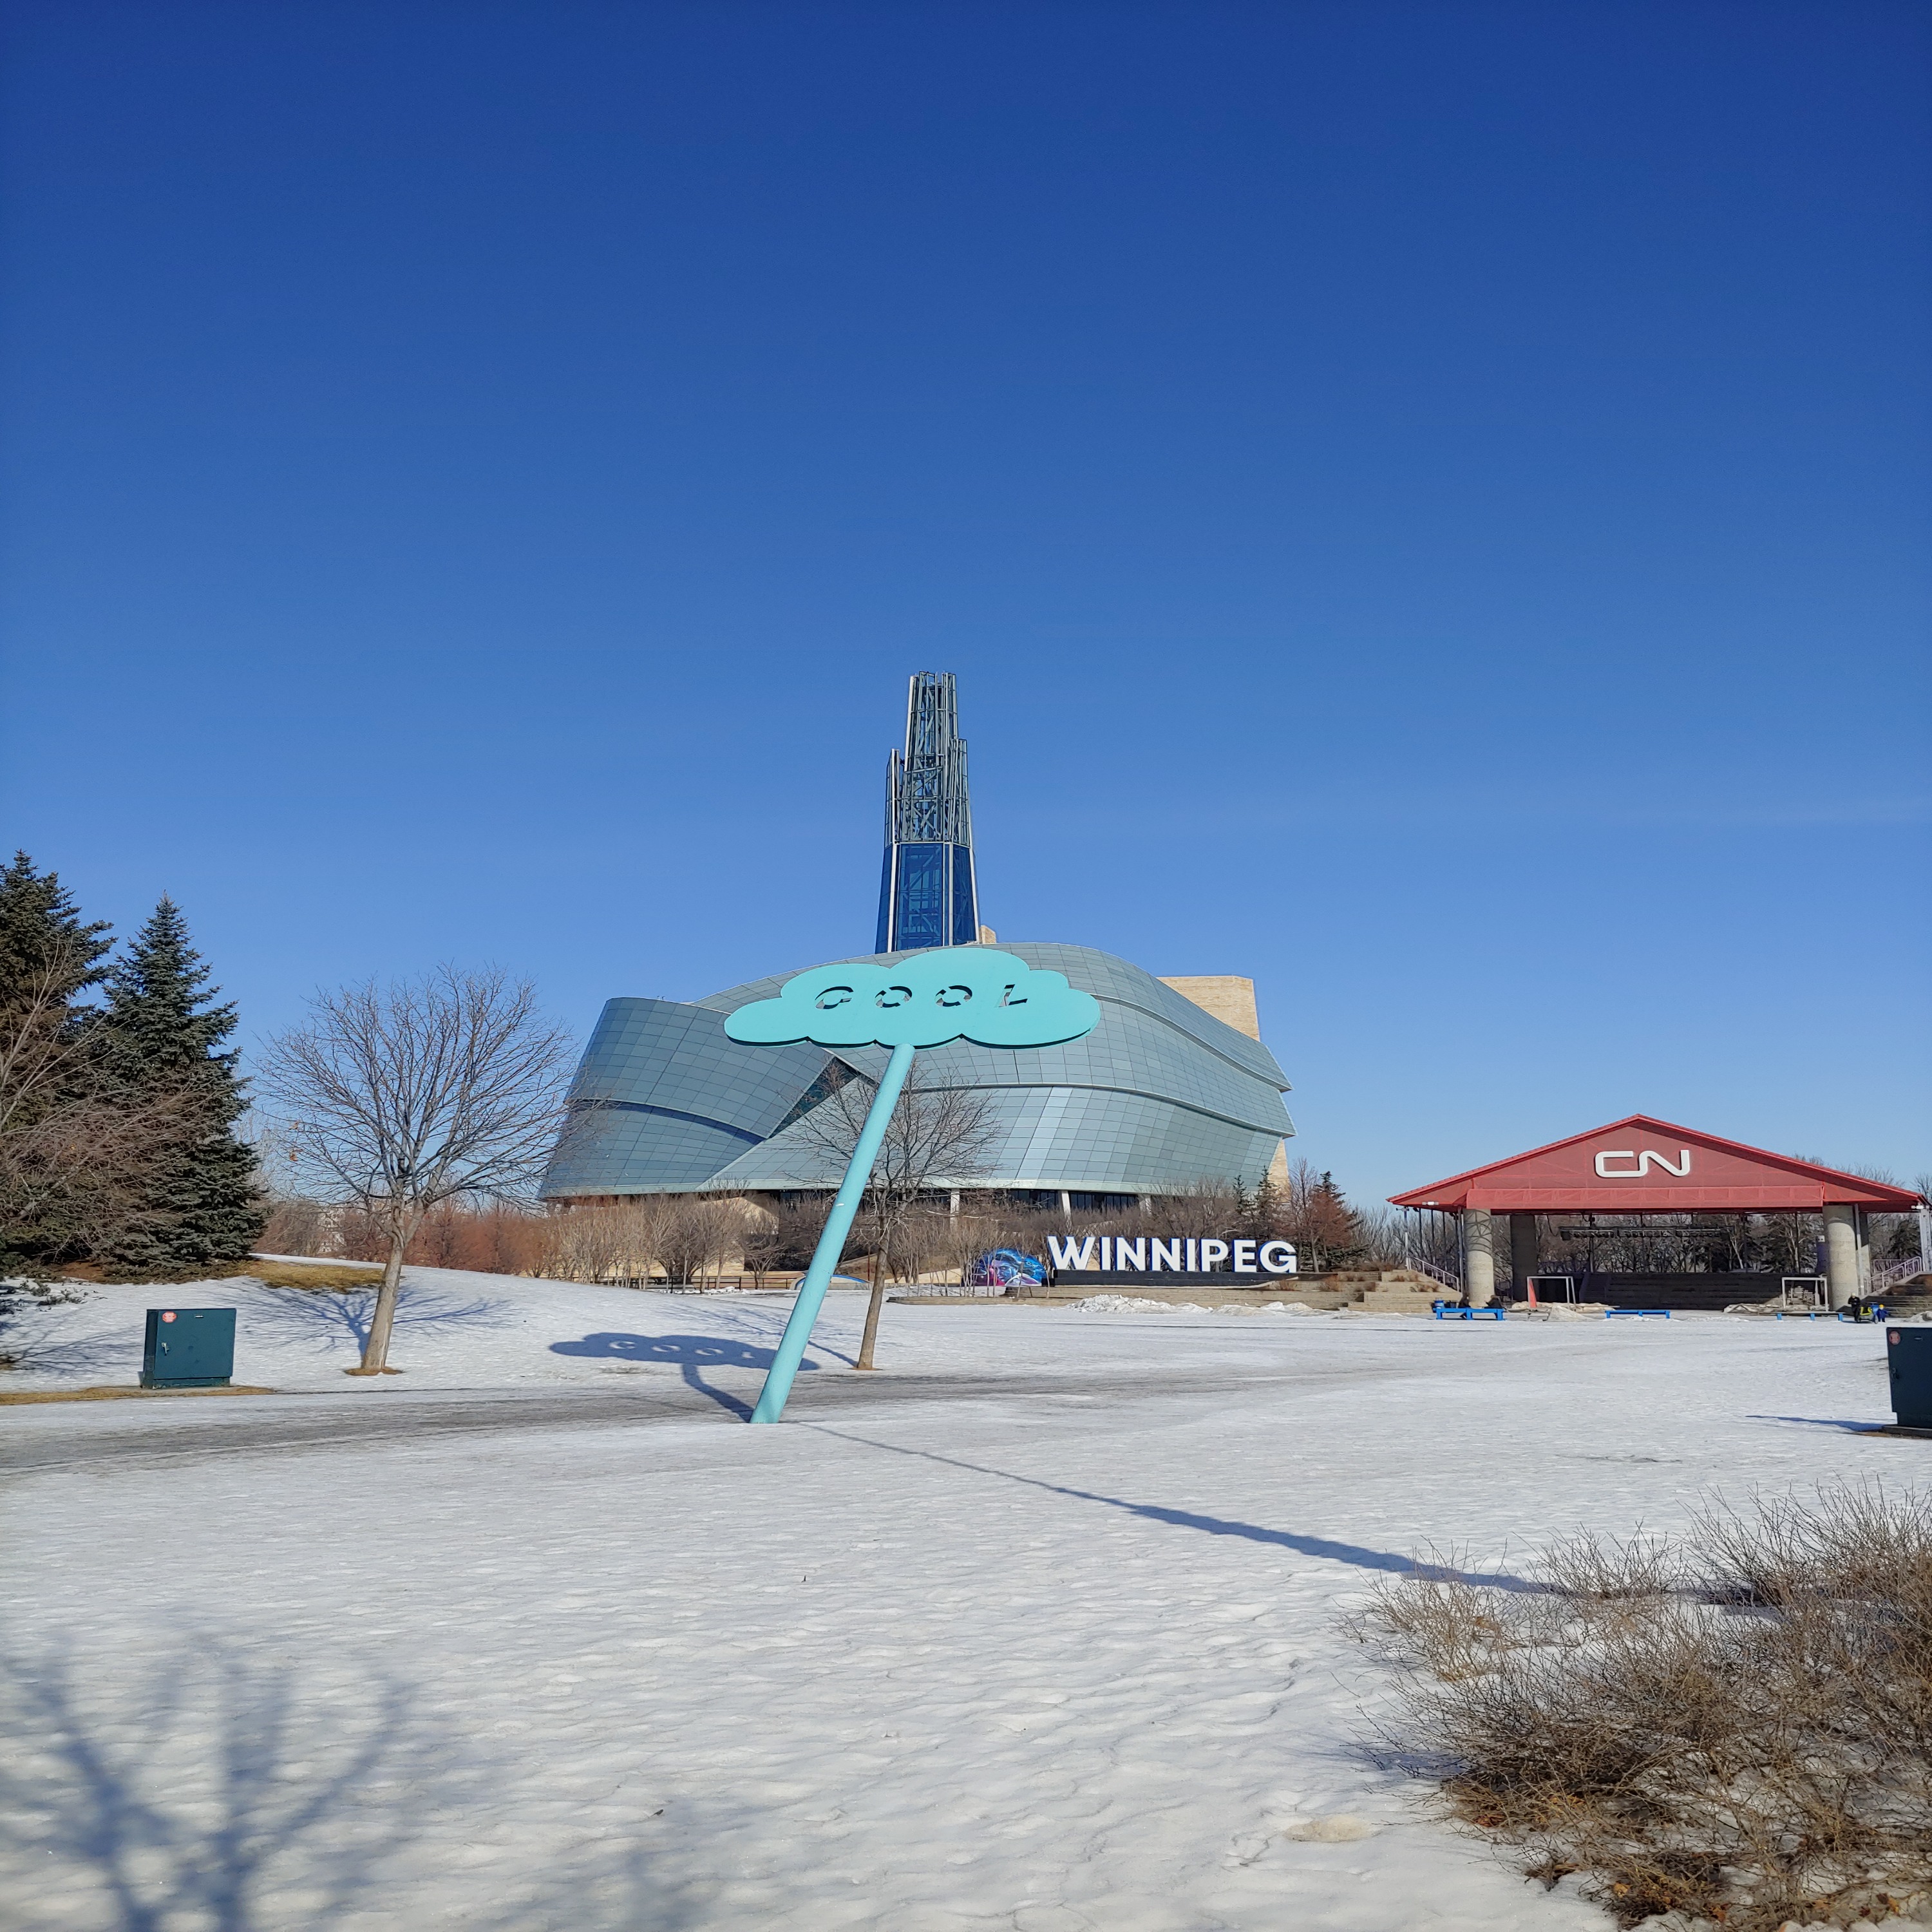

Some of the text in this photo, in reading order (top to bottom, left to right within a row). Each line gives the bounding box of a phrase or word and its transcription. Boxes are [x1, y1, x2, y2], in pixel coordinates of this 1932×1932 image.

[814, 983, 1028, 1010] COOL
[1595, 1150, 1690, 1178] CN
[1046, 1235, 1298, 1273] WINNIPEG
